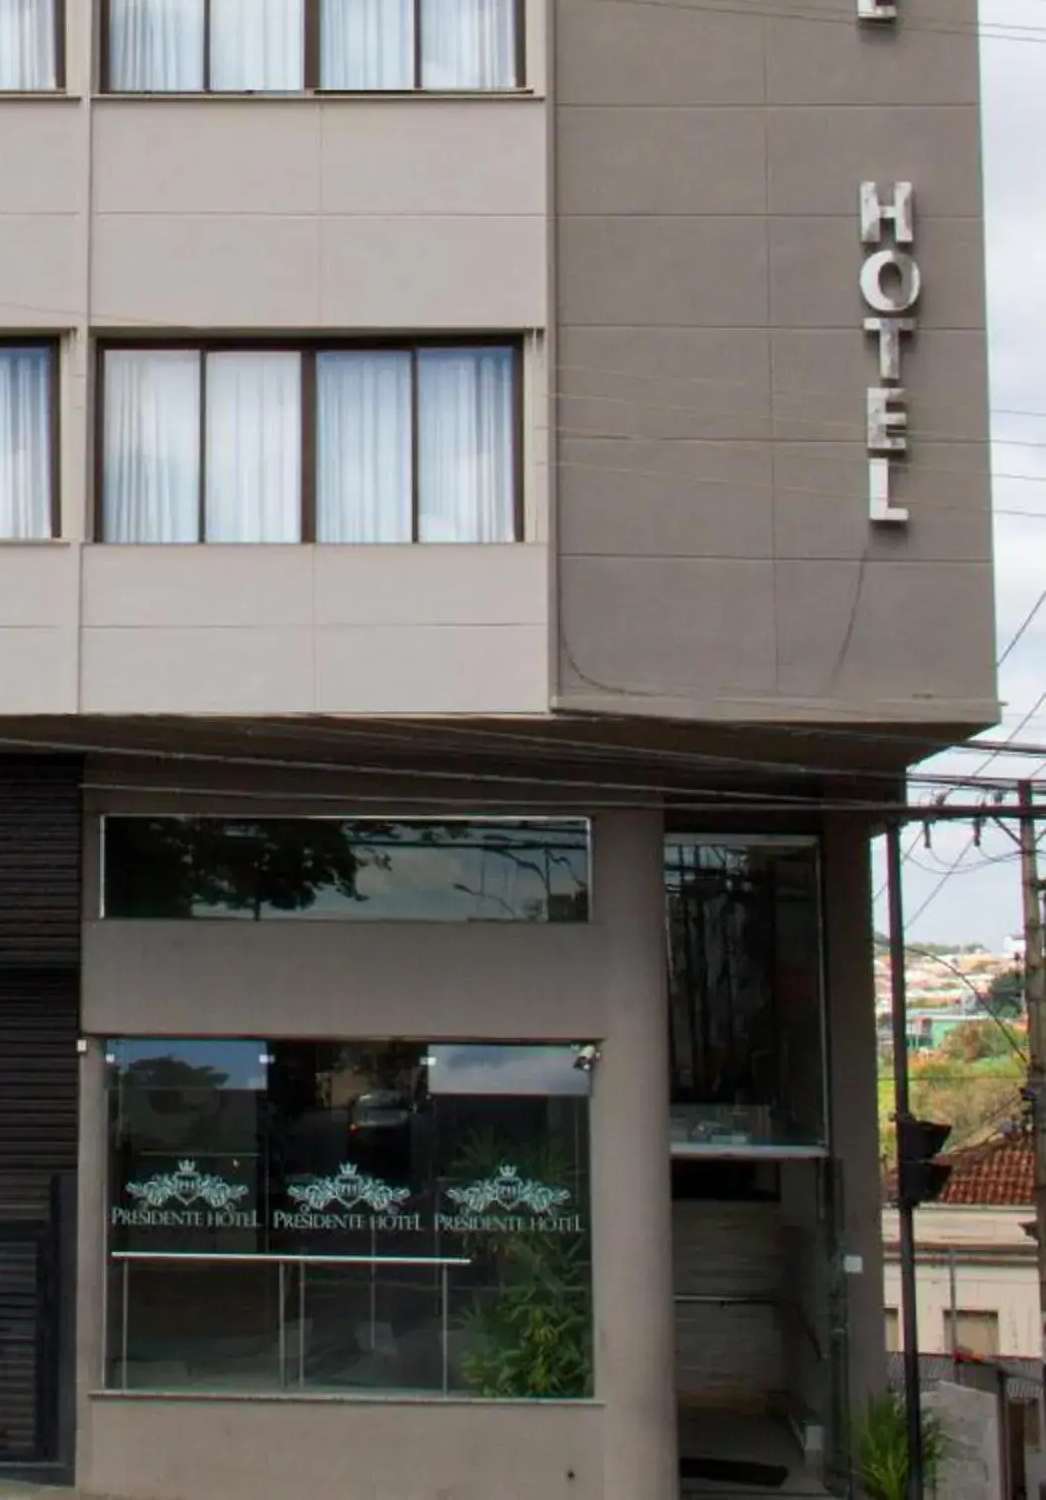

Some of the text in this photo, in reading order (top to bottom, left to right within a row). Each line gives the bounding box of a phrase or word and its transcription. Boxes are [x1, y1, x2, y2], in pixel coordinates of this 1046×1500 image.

[859, 181, 920, 521] HOTEL
[111, 1207, 203, 1226] PRESIDENTE
[273, 1210, 367, 1229] PRESIDENTE
[434, 1212, 527, 1232] PRESIDENTE
